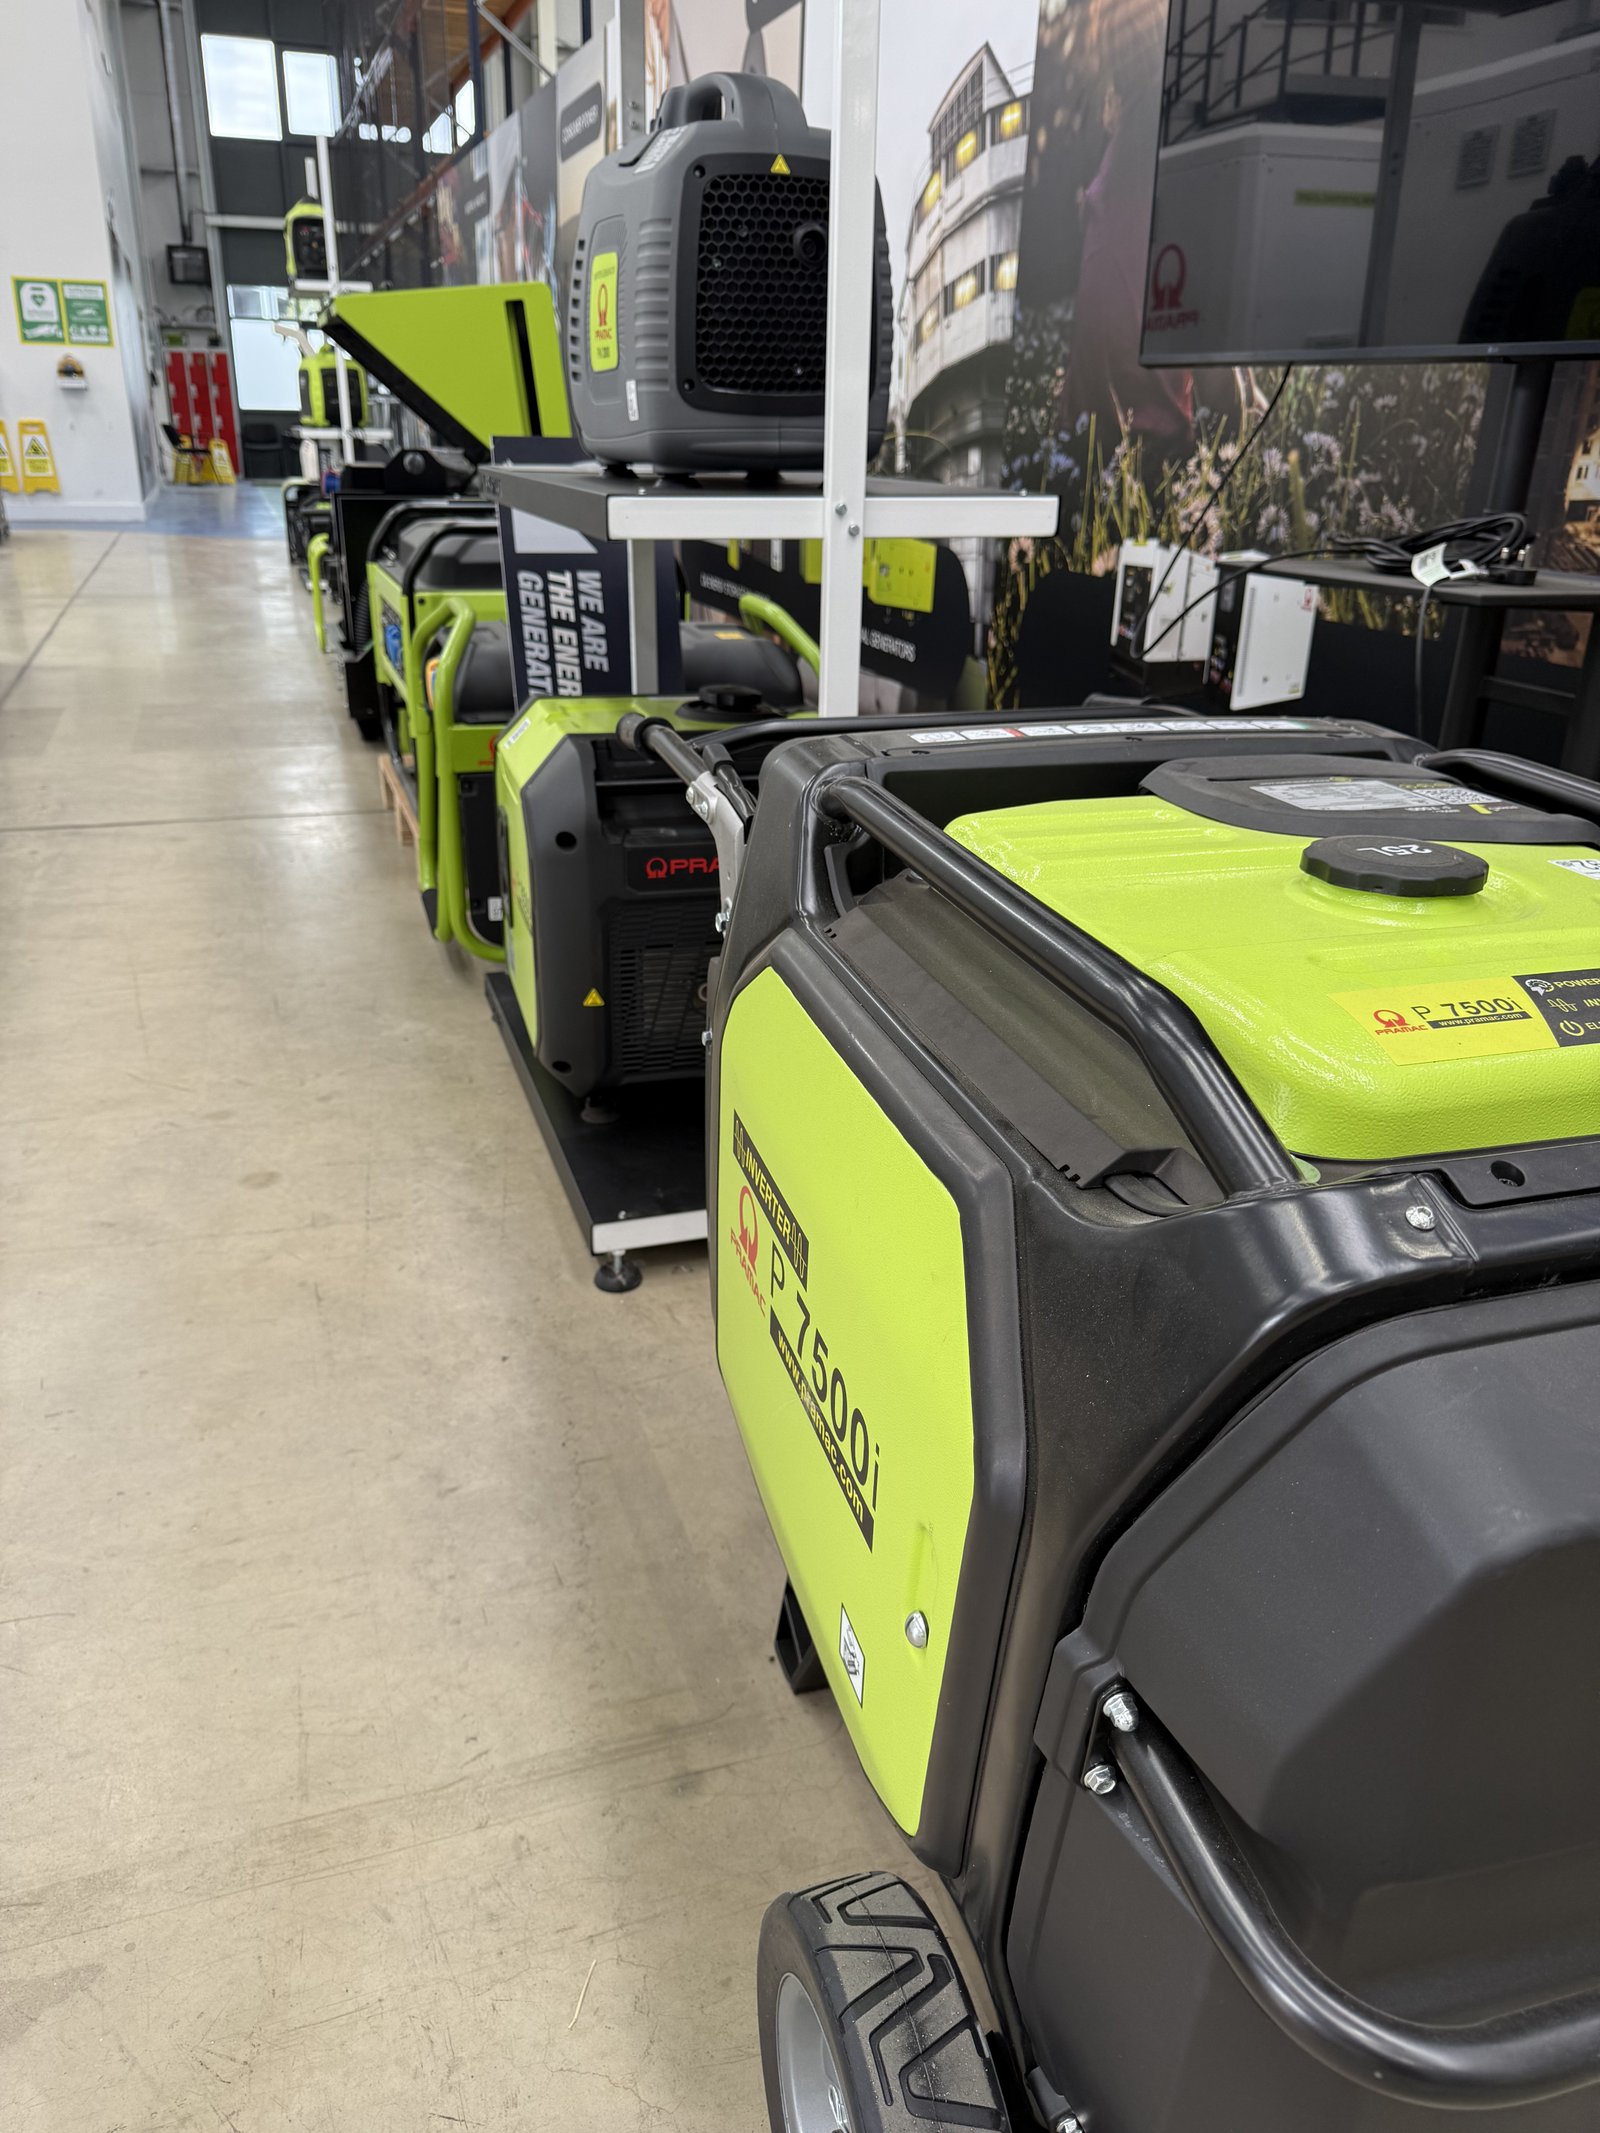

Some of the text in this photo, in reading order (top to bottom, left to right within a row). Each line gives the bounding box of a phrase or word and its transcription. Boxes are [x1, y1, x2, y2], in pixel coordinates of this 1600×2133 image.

[547, 570, 583, 697] THE ENER
[576, 570, 609, 673] WE ARE
[1356, 844, 1432, 857] 25L
[1375, 1024, 1428, 1036] PRAMAC
[1411, 997, 1524, 1020] P 7500i
[1438, 1013, 1524, 1027] www.pramac.com
[745, 1147, 792, 1245] INVERTER
[730, 1227, 766, 1318] PRAMAC
[770, 1239, 879, 1512] P 7500i
[778, 1330, 864, 1524] www.pramac.com
